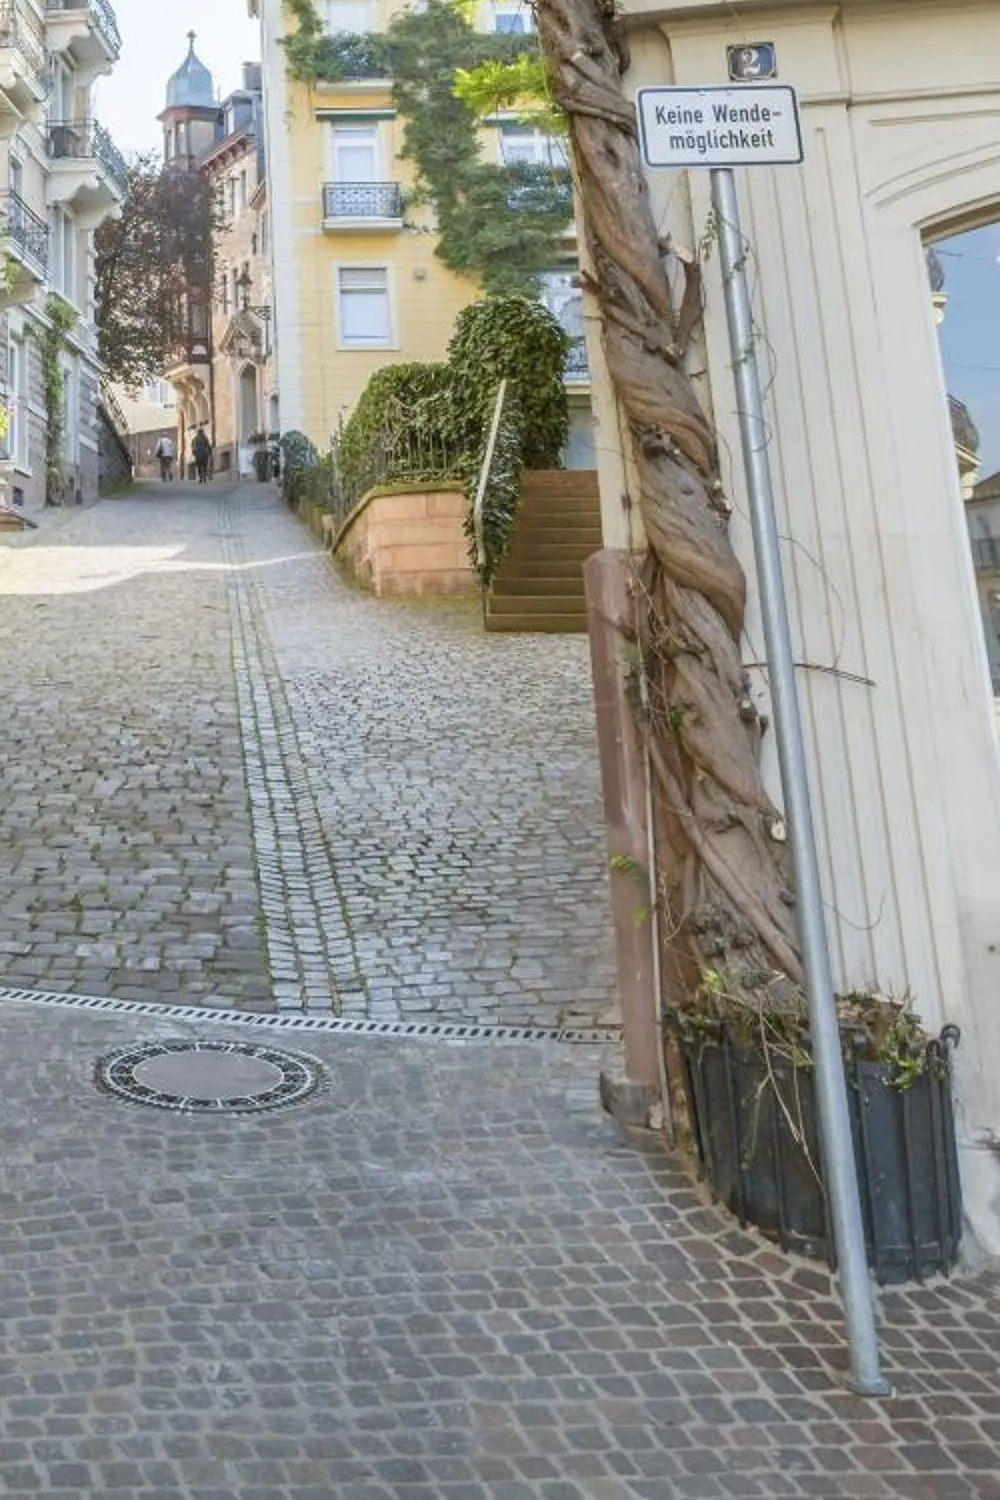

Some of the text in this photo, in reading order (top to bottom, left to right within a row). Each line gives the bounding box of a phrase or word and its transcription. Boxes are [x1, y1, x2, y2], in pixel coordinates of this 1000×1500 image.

[741, 47, 761, 74] 2
[655, 103, 783, 125] Keine Wende-
[669, 128, 775, 154] möglichkeit
